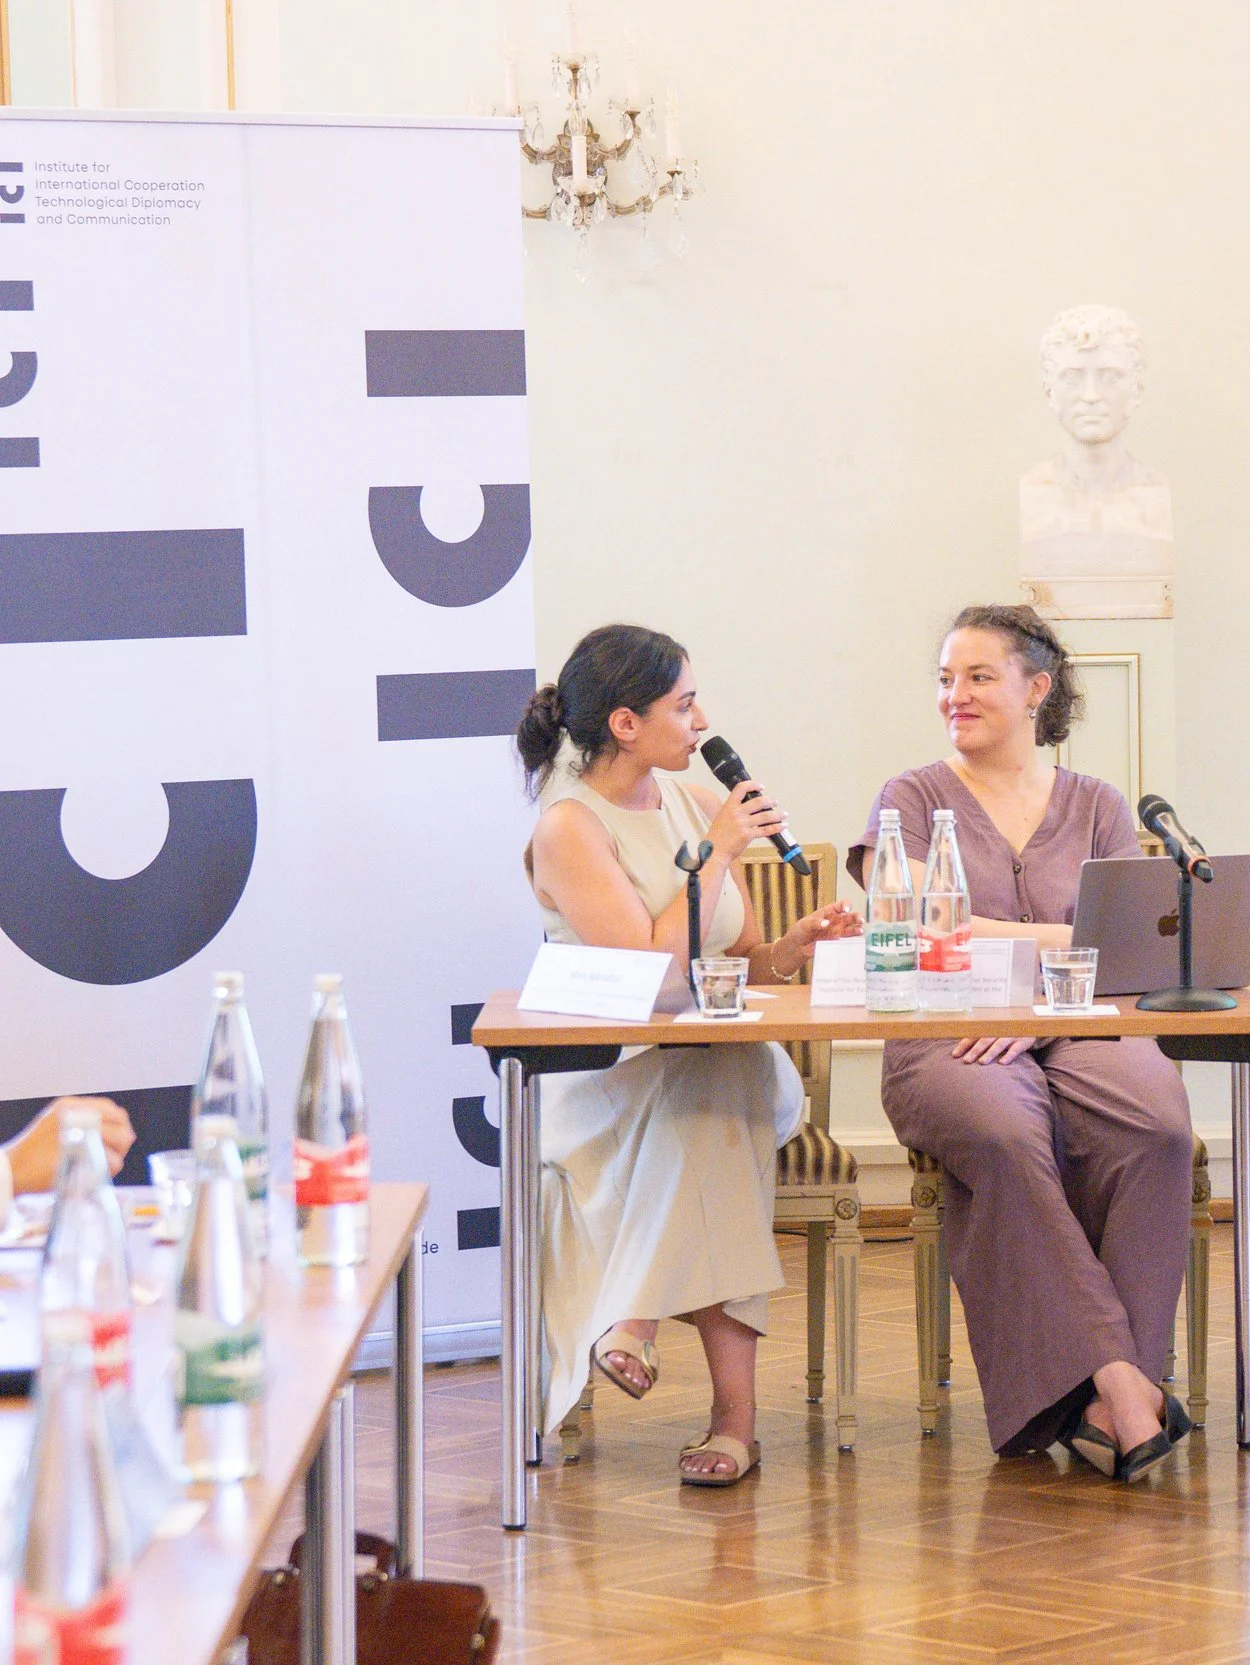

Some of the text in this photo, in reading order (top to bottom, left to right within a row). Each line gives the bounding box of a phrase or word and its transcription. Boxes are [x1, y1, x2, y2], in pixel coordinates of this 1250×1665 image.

[35, 161, 110, 172] Institute for
[35, 179, 205, 192] International Cooperation
[34, 196, 201, 210] Technological Diplomacy
[37, 213, 171, 225] and Communication
[871, 932, 912, 947] EIFEL
